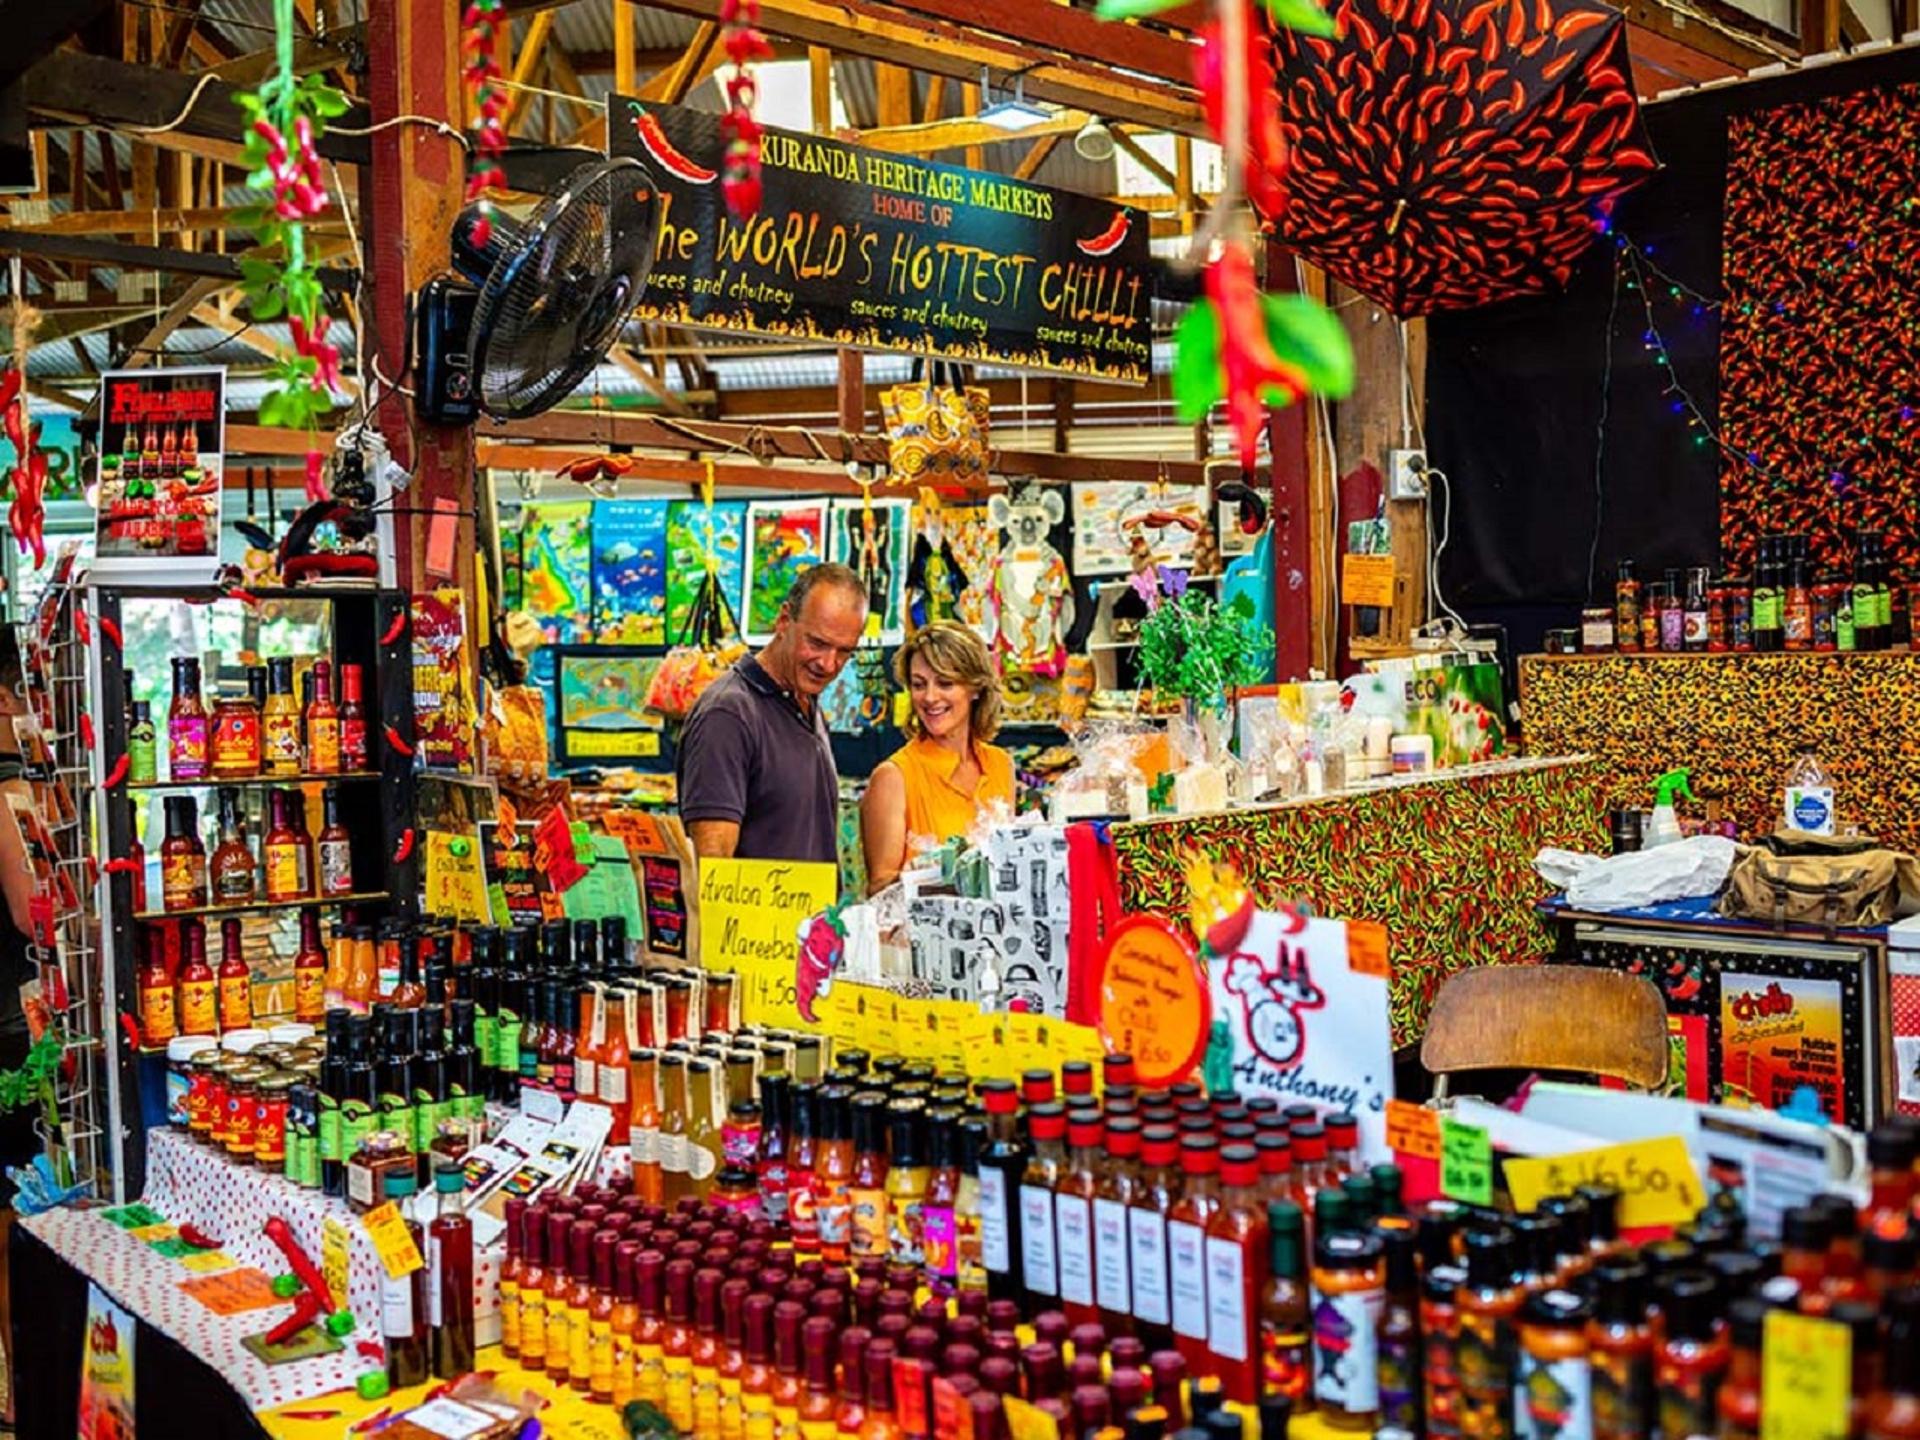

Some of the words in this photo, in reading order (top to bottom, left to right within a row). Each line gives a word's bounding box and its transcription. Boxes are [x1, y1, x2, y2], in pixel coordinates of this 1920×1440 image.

[759, 133, 860, 183] KURANDA
[864, 157, 966, 203] HERITAGE
[968, 178, 1054, 221] MARKETS
[872, 193, 926, 223] HOME
[930, 203, 952, 227] OF
[692, 269, 725, 296] and
[728, 271, 795, 313] chutney
[715, 212, 878, 286] WORLD'S
[887, 231, 1037, 310] HOTTEST
[1038, 261, 1143, 330] CHILLI
[850, 299, 898, 320] sauces
[901, 300, 931, 325] and
[932, 302, 988, 337] chutney
[1036, 325, 1077, 345] sauces
[1081, 327, 1104, 349] and
[1105, 328, 1151, 364] chutney
[1405, 679, 1438, 701] ECO
[701, 864, 761, 907] Avalon
[766, 867, 812, 916] Farm
[720, 916, 796, 961] Mareeba
[751, 971, 797, 1006] 14.50
[1233, 1055, 1384, 1116] Anthony's
